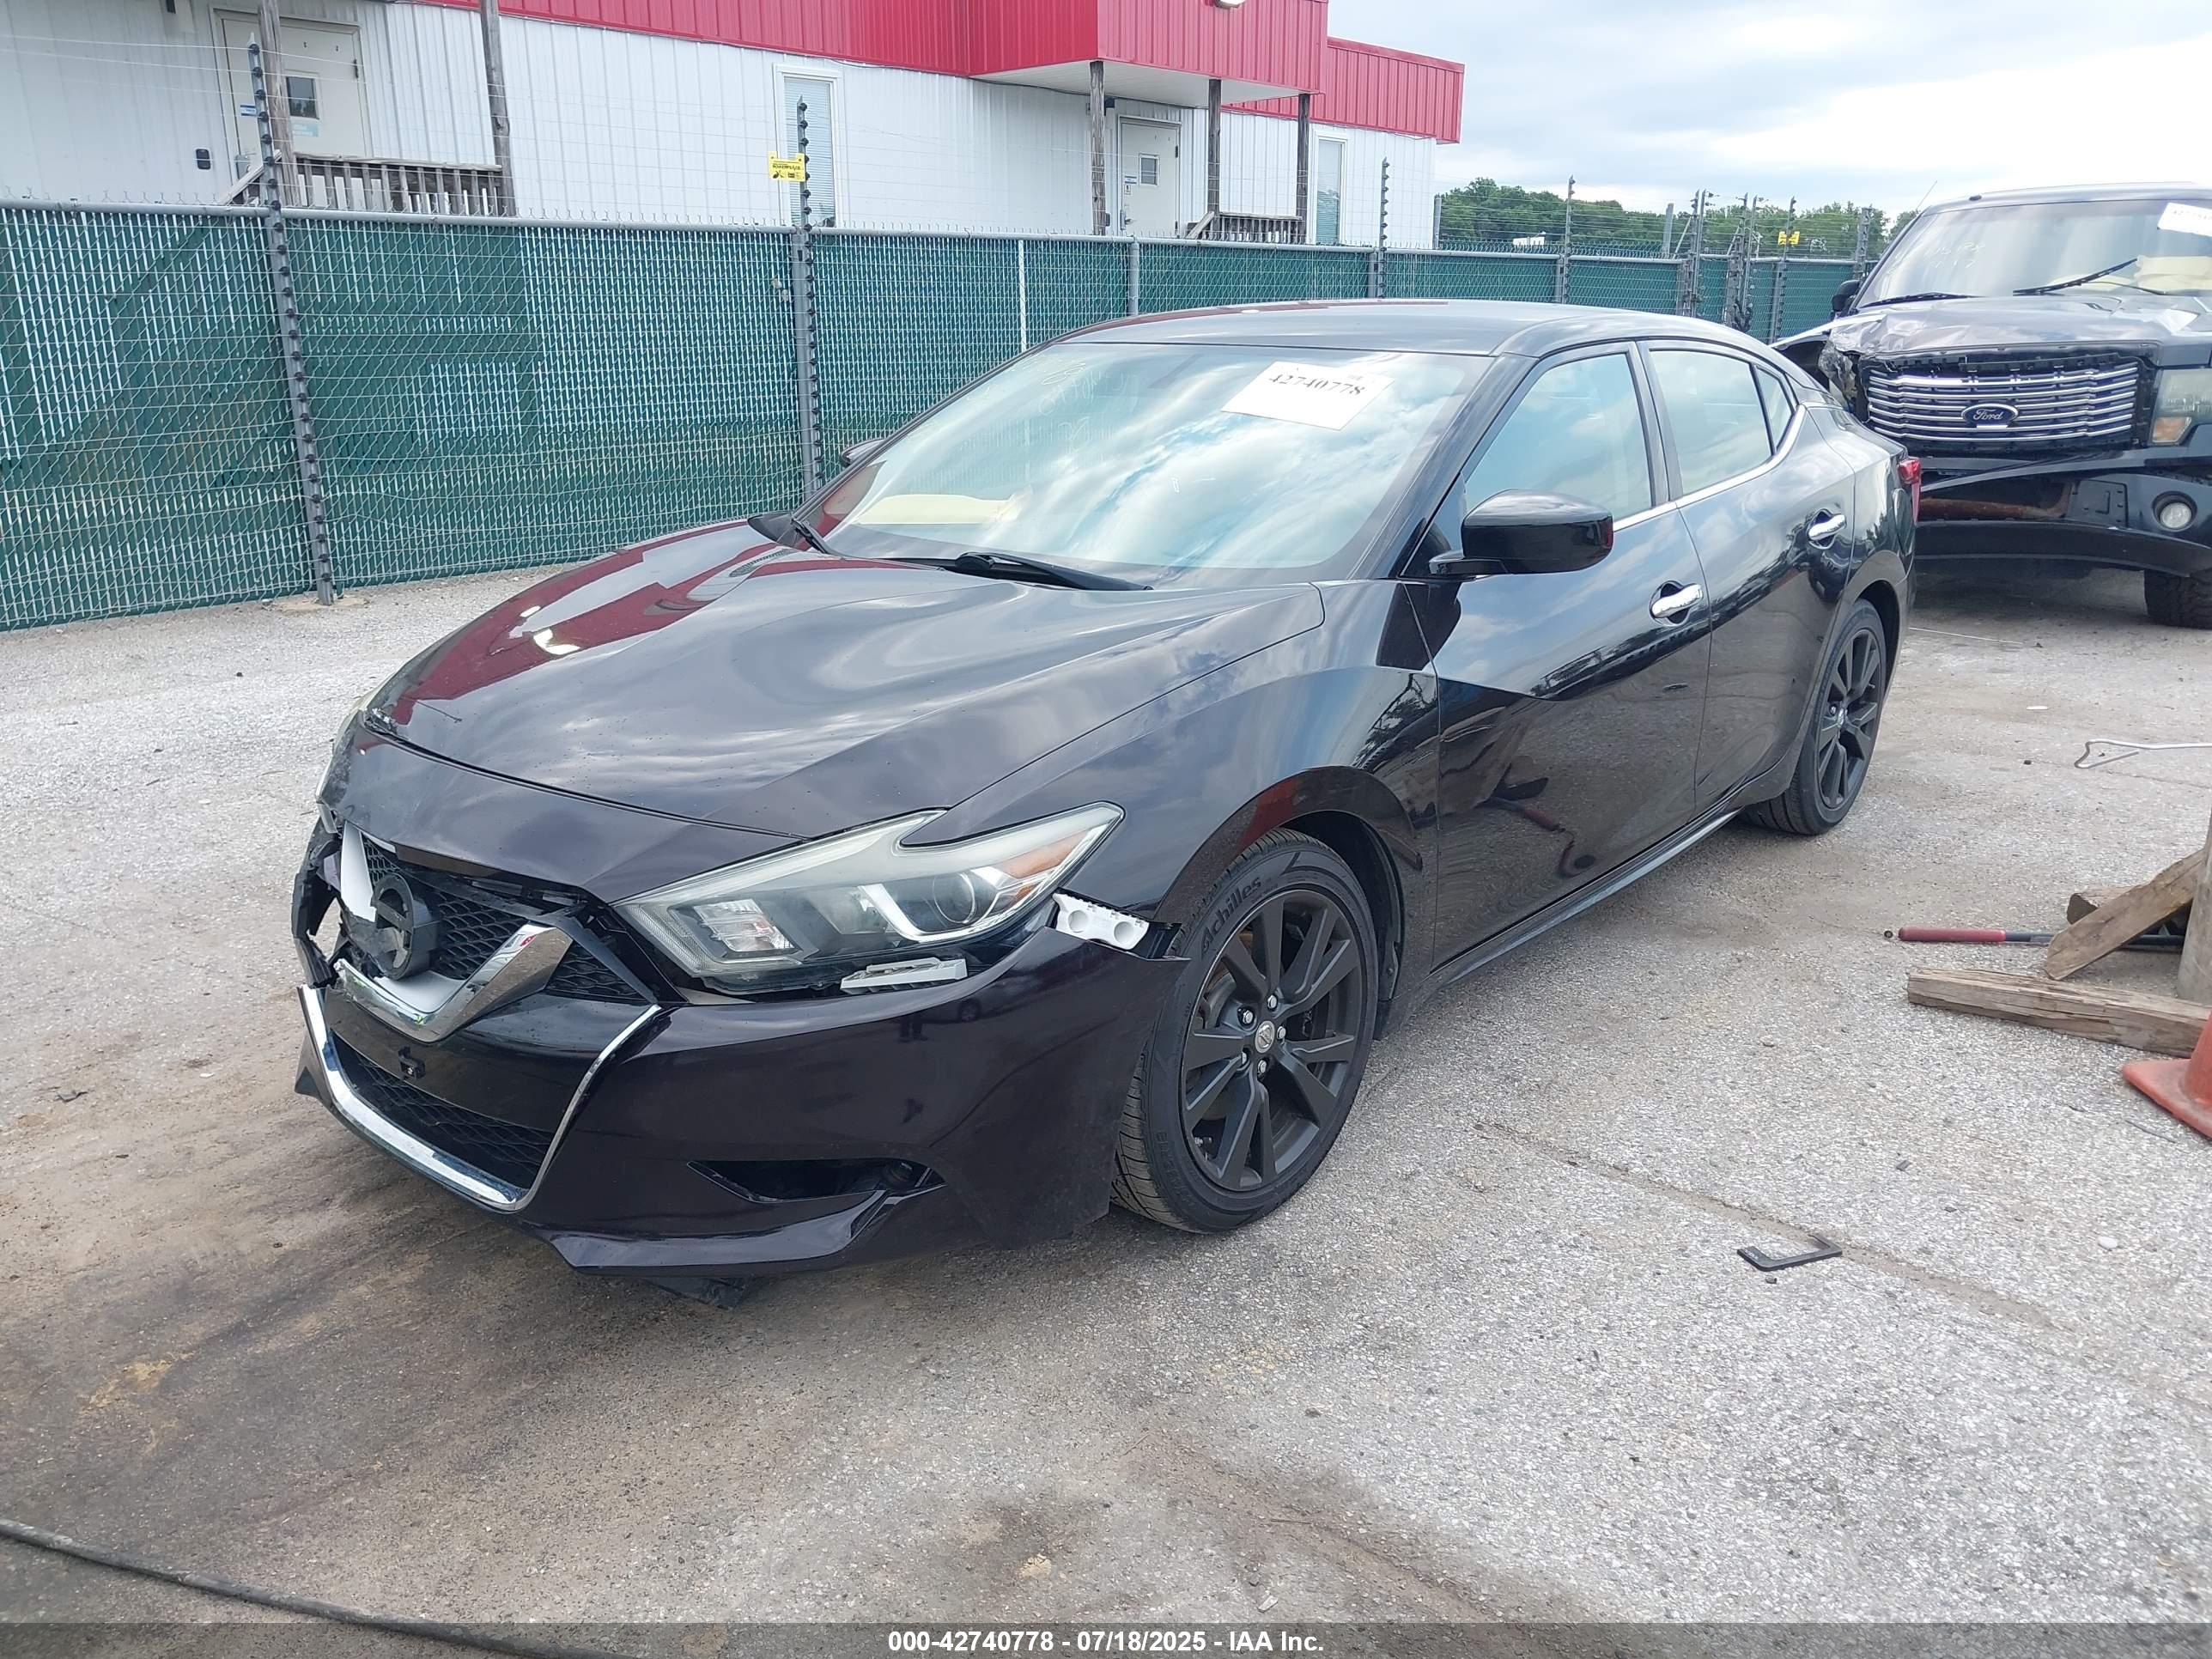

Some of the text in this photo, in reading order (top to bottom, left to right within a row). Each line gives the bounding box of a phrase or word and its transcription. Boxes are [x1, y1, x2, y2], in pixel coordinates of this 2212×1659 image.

[1268, 373, 1365, 396] 42740778
[1973, 408, 2003, 420] Ford
[1202, 877, 1261, 954] Achilles
